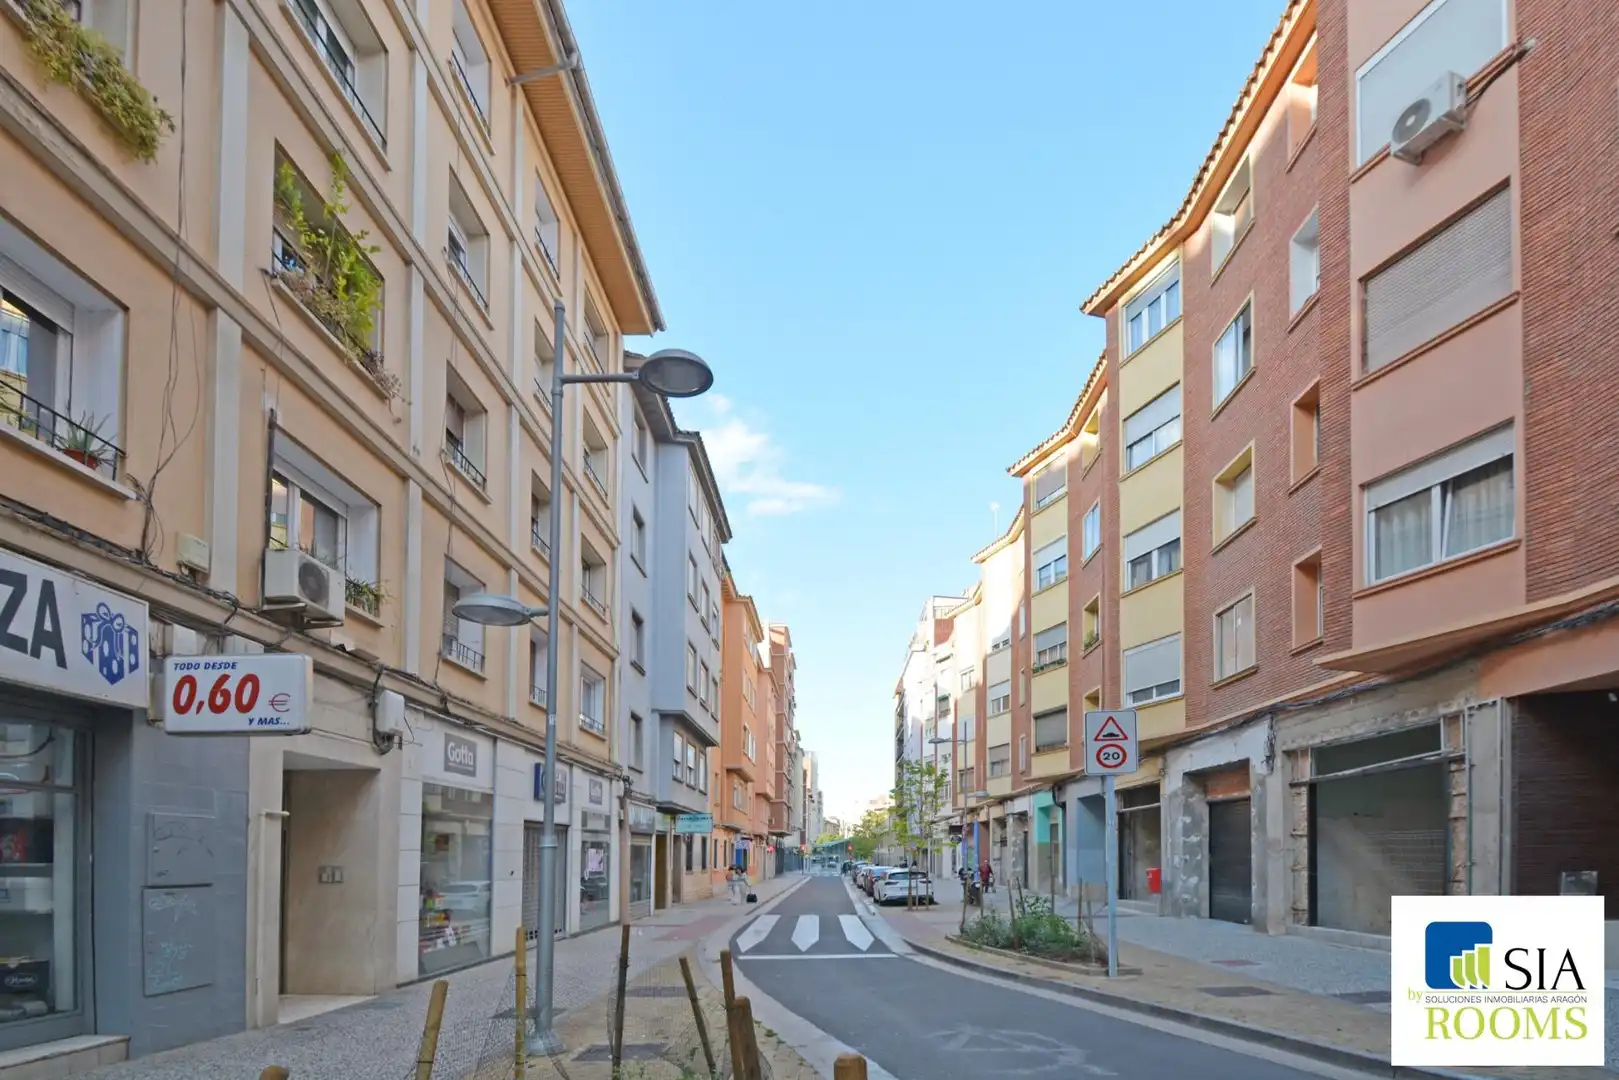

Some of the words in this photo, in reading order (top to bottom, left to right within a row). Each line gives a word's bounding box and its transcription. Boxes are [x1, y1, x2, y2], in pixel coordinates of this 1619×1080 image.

[174, 662, 201, 671] TODO
[203, 661, 238, 670] DESDE
[172, 673, 260, 716] 0,60
[268, 692, 291, 713] €
[248, 717, 255, 726] Y
[447, 741, 474, 766] Gotta
[1102, 751, 1121, 761] 20
